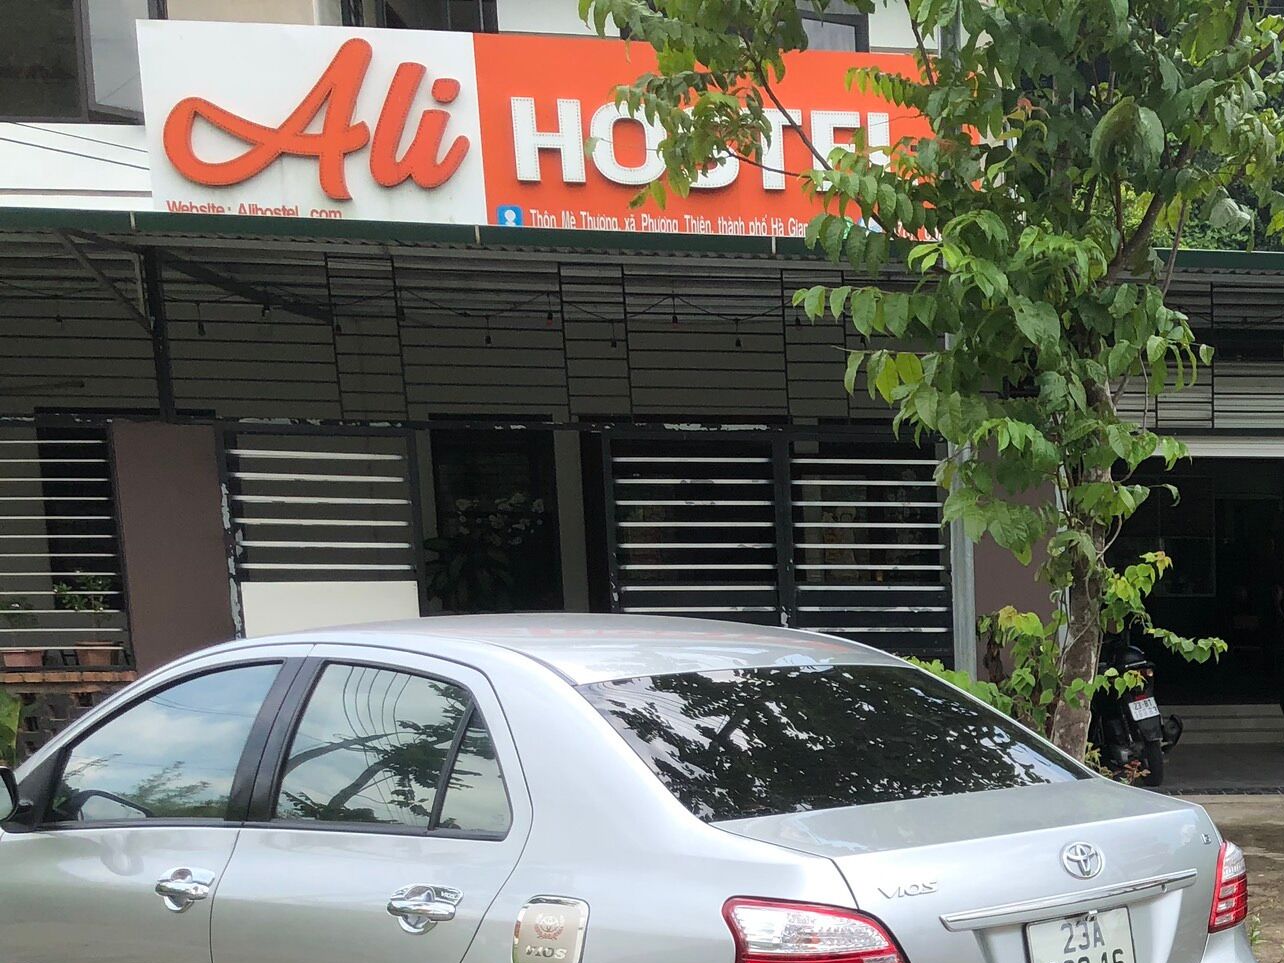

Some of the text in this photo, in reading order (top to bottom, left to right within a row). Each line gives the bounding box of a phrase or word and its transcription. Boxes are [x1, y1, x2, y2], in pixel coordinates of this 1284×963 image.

[163, 38, 470, 200] Ali
[877, 881, 937, 900] VIOS
[1060, 919, 1105, 954] 23A
[525, 945, 568, 960] VIOS
